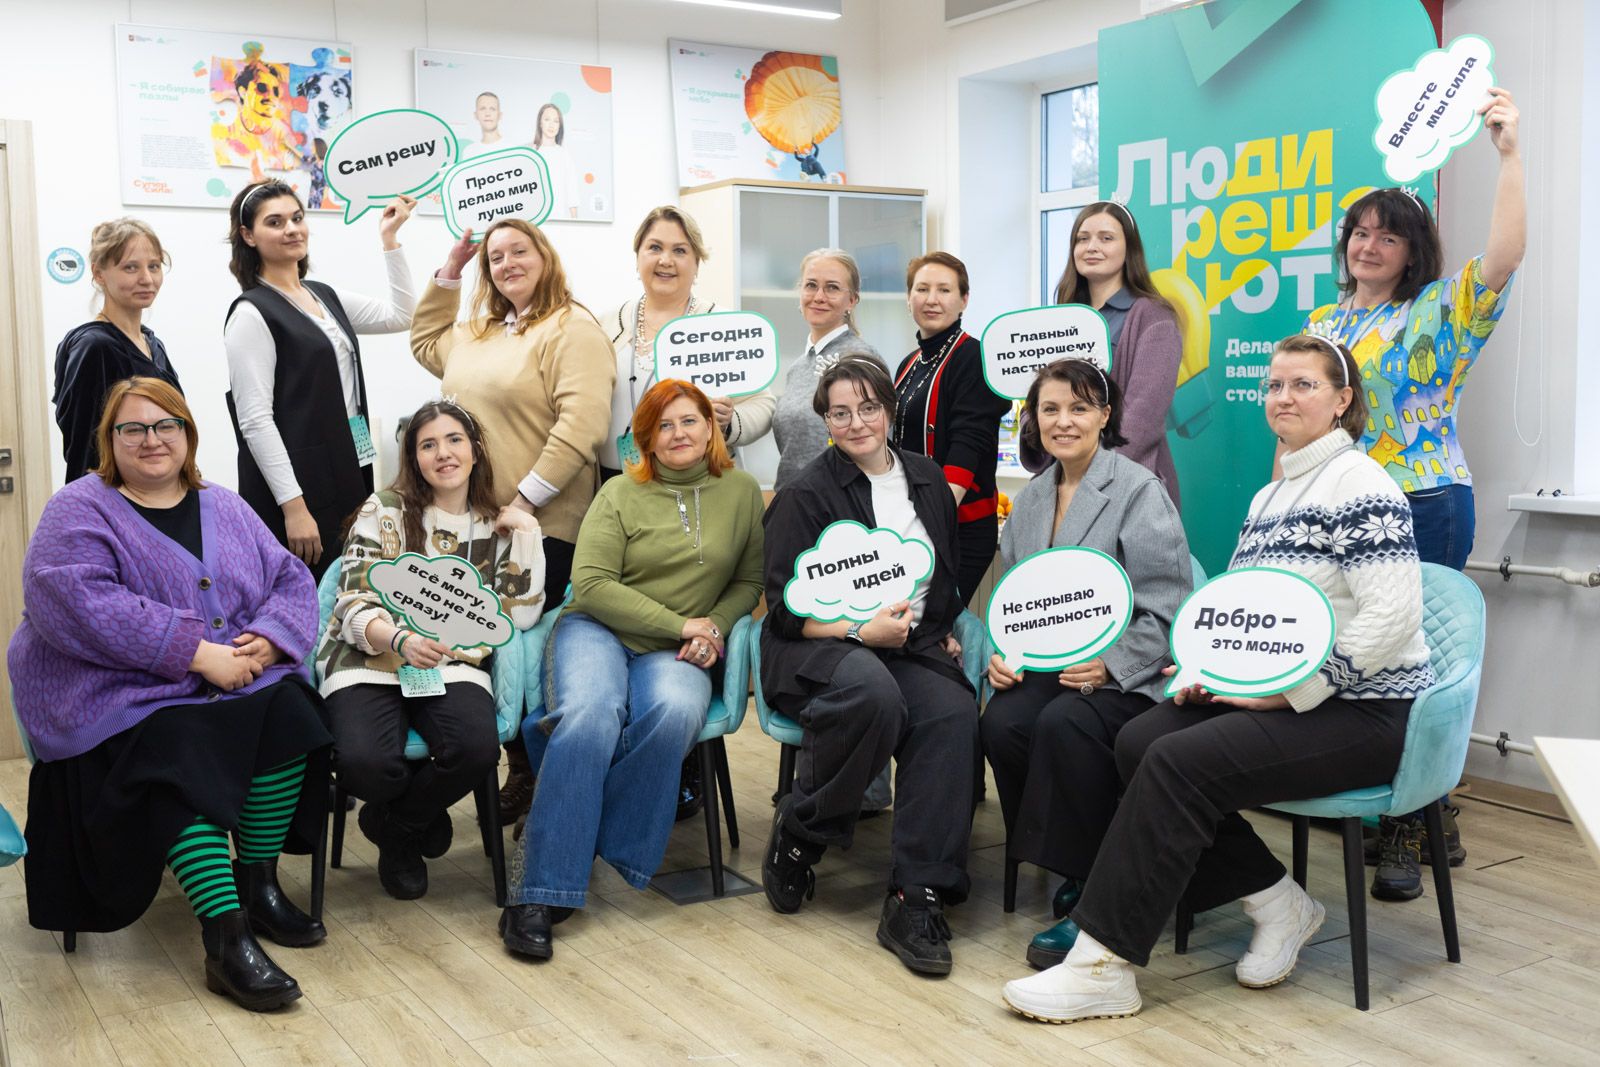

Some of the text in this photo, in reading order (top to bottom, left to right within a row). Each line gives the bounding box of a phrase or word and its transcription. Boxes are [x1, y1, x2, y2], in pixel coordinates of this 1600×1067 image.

[1426, 57, 1477, 128] мы сила
[1388, 82, 1437, 148] Вместе
[338, 140, 436, 175] Сам решу
[1110, 128, 1333, 206] Люди
[466, 168, 523, 189] Просто
[458, 190, 505, 210] делаю
[508, 181, 538, 194] мир
[478, 203, 524, 222] лучше
[669, 327, 763, 345] Сегодня
[1010, 325, 1079, 344] Главный
[669, 348, 764, 367] я двигаю
[997, 341, 1095, 361] по хорошему
[691, 371, 746, 387] горы
[450, 567, 466, 581] Я
[806, 550, 880, 580] Полны
[852, 562, 906, 590] идей
[407, 564, 486, 610] всё могу,
[392, 590, 450, 623] сразу!
[420, 587, 497, 631] но не все
[1003, 588, 1094, 616] Не скрываю
[1004, 604, 1112, 634] гениальности
[1194, 607, 1277, 634] Добро
[1211, 638, 1305, 655] это модно
